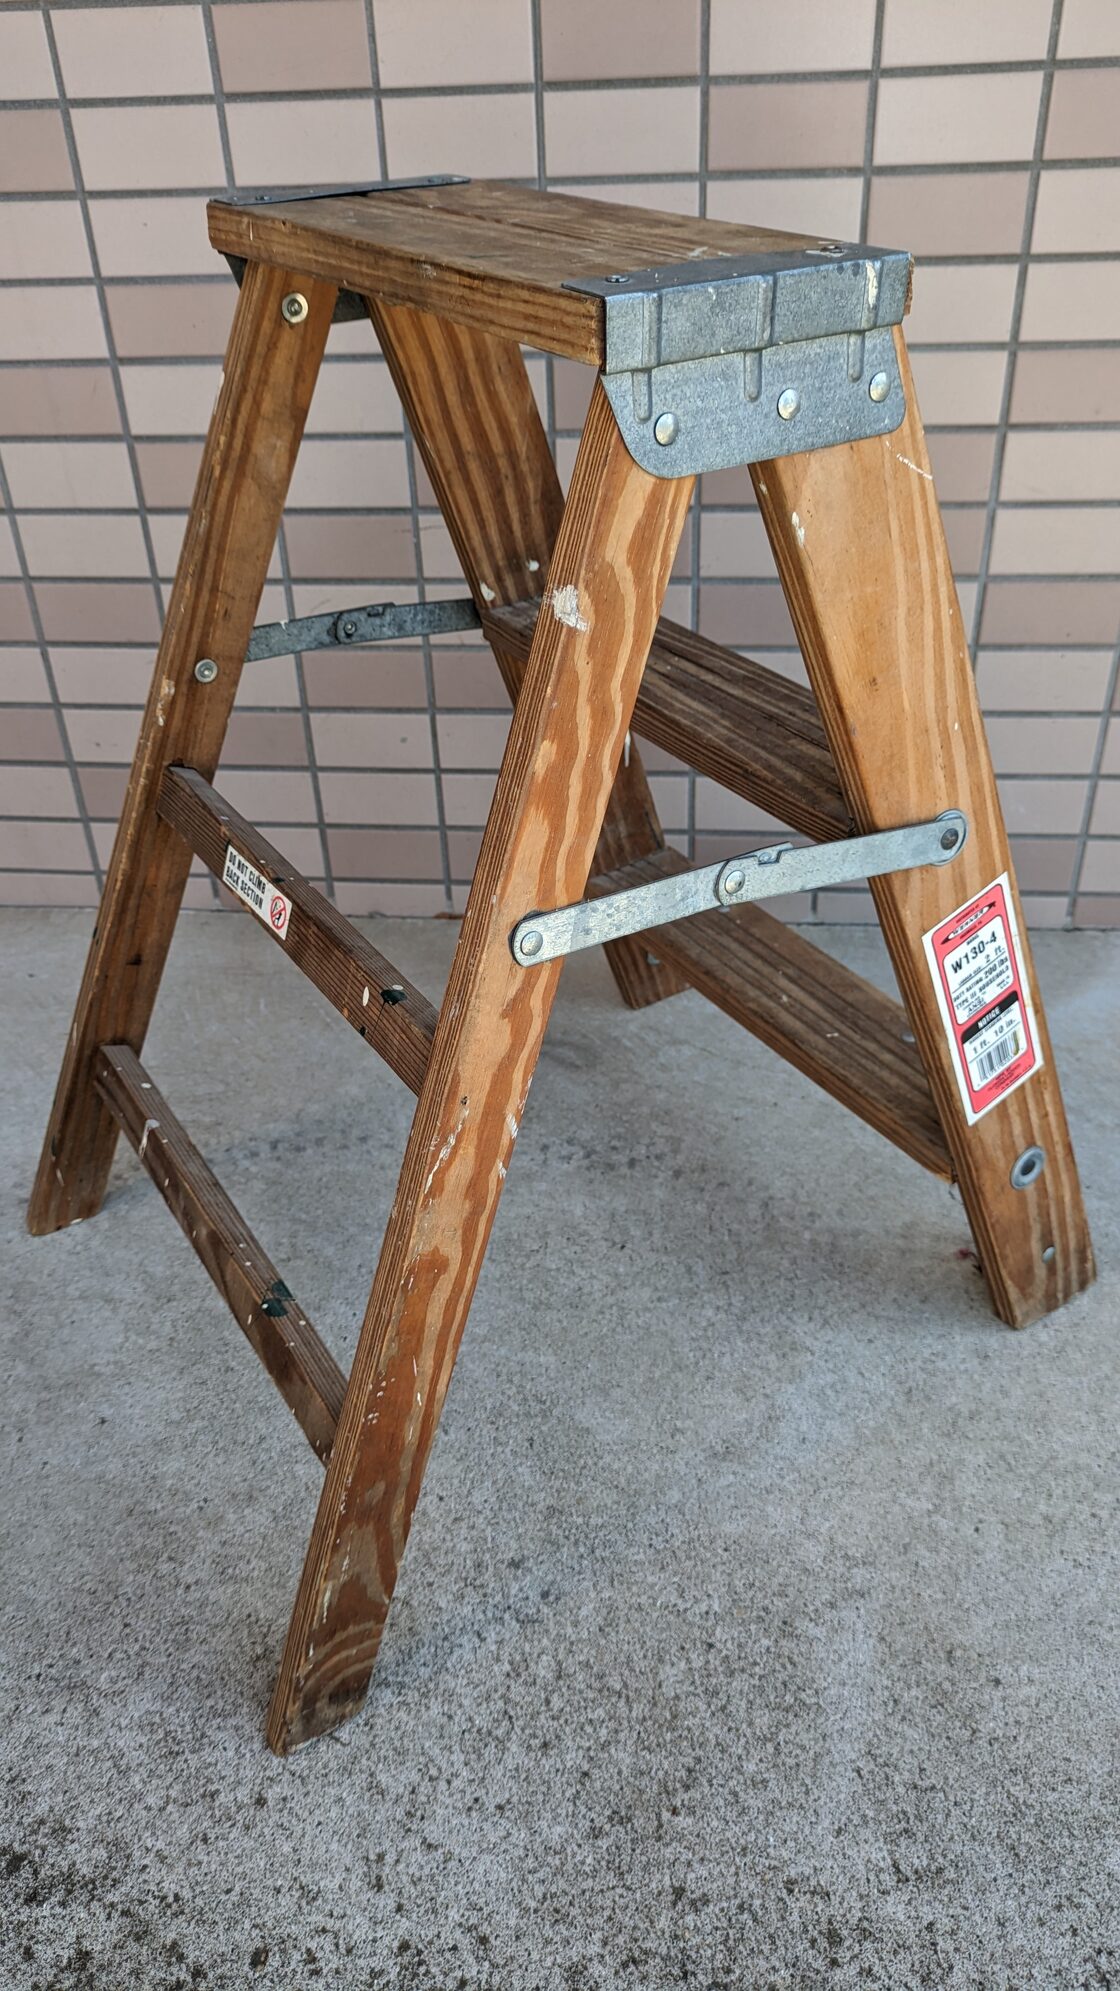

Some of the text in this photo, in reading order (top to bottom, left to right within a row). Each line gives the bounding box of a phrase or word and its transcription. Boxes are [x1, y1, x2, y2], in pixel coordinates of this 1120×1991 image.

[226, 866, 240, 886] BACK
[240, 880, 264, 910] SECTION
[229, 851, 237, 866] DO
[237, 859, 248, 878] NOT
[249, 870, 266, 895] CLIMB
[951, 930, 997, 974] W130-4
[984, 963, 997, 979] 200
[978, 1005, 1000, 1029] NOTICE
